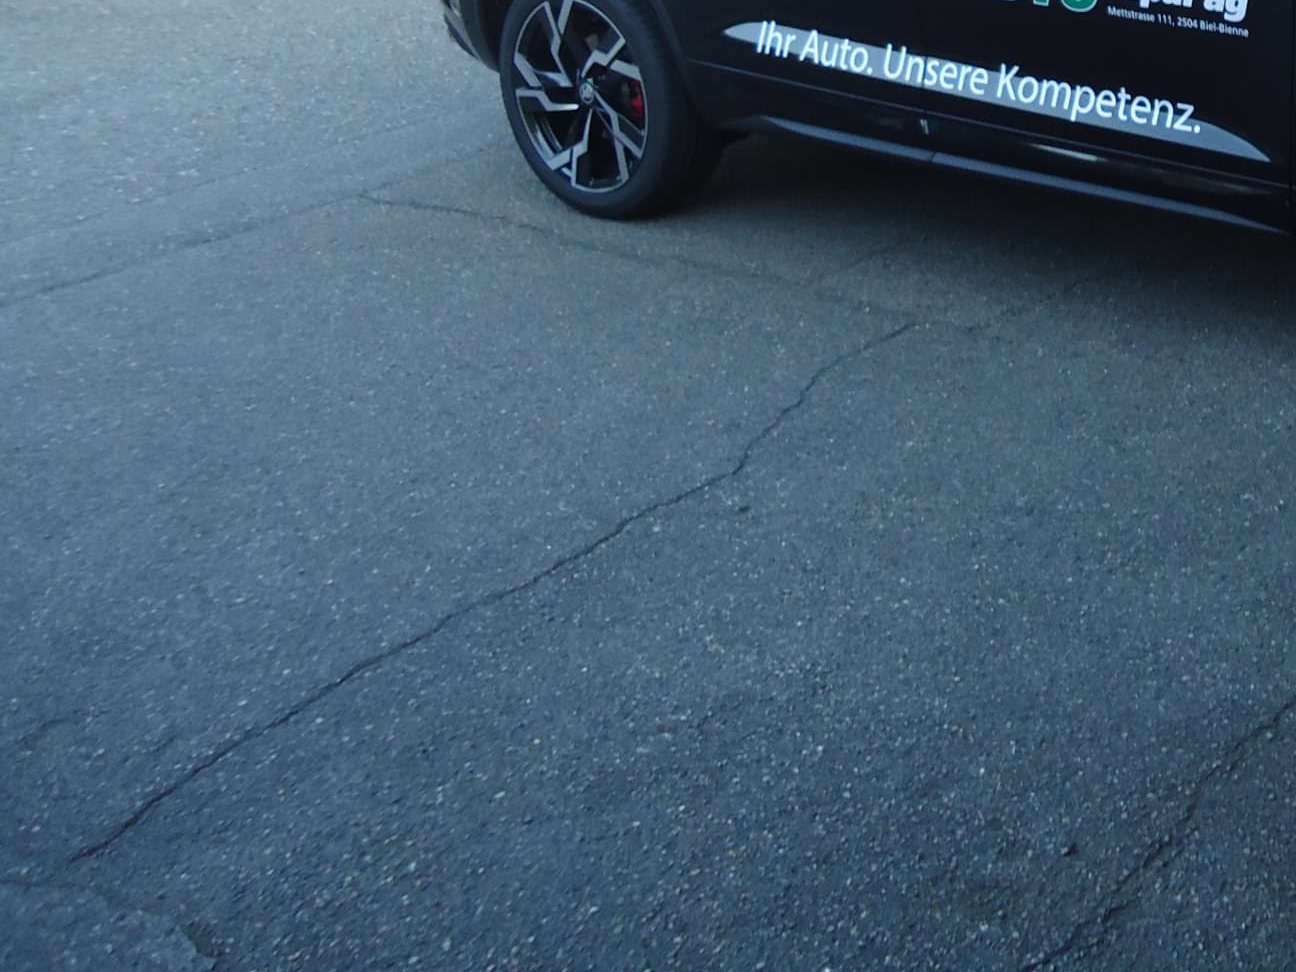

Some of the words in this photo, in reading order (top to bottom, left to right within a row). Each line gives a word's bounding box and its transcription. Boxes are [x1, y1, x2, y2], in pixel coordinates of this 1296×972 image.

[1107, 6, 1155, 22] Mettstrasse
[1177, 16, 1198, 29] 2504
[757, 20, 796, 59] Ihr
[799, 29, 874, 77] Auto.
[882, 43, 989, 95] Unsere
[996, 63, 1202, 134] Kompetenz.
